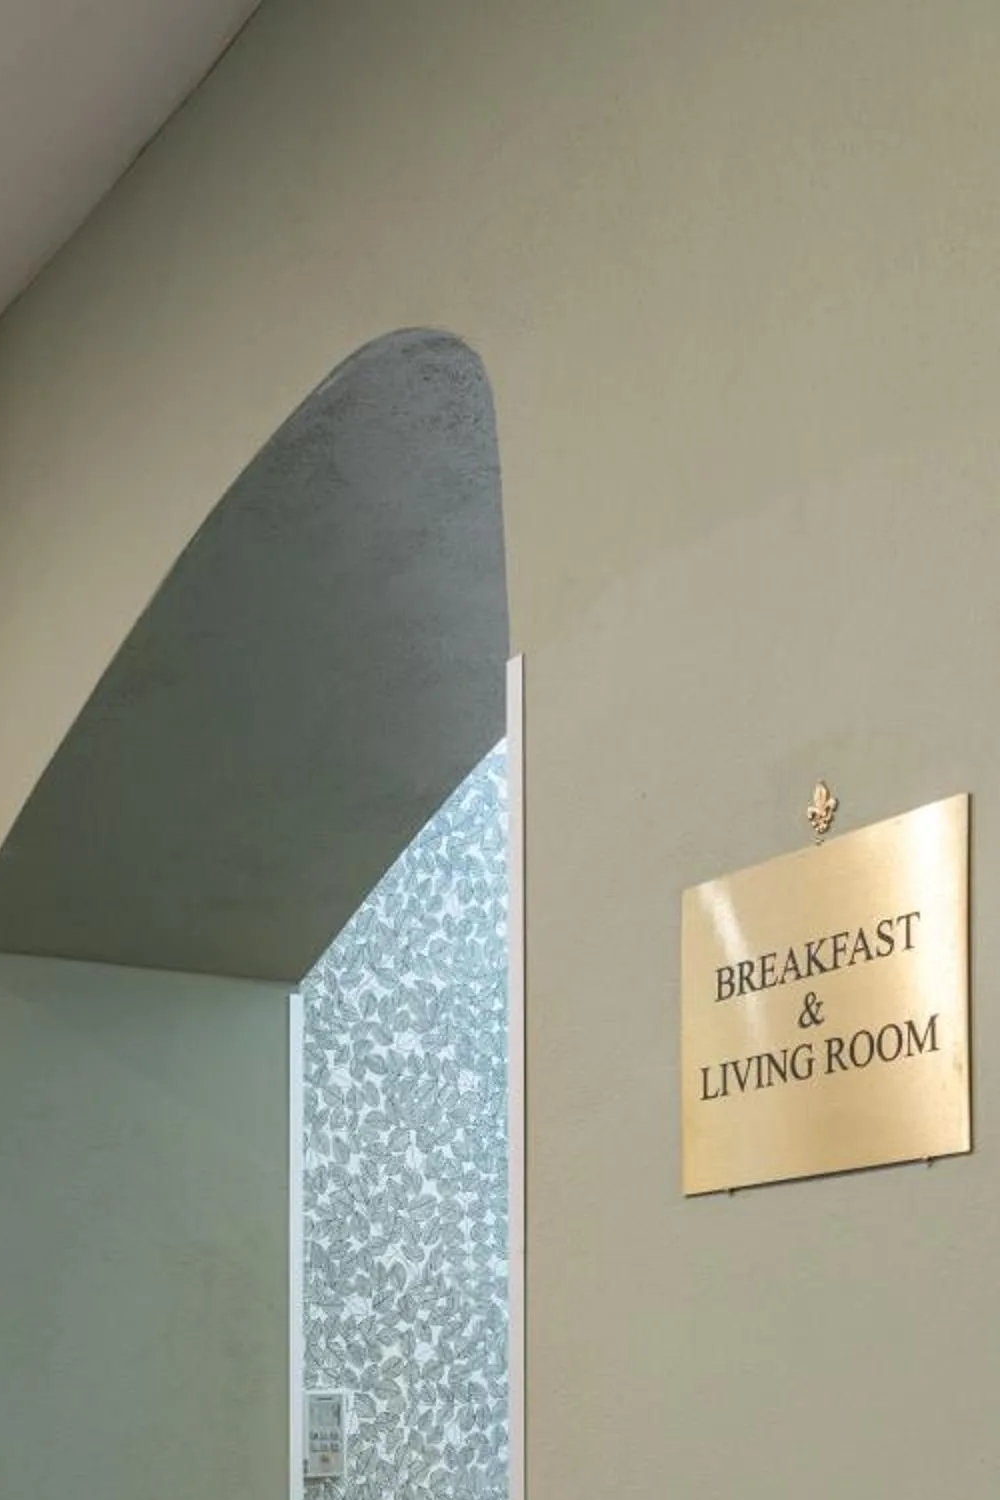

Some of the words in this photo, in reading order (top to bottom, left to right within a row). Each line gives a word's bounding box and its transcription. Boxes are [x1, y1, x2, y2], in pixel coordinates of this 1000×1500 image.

[714, 911, 921, 1002] BREAKFAST
[797, 991, 825, 1029] &
[700, 1043, 815, 1101] LIVING
[824, 1013, 940, 1075] ROOM
